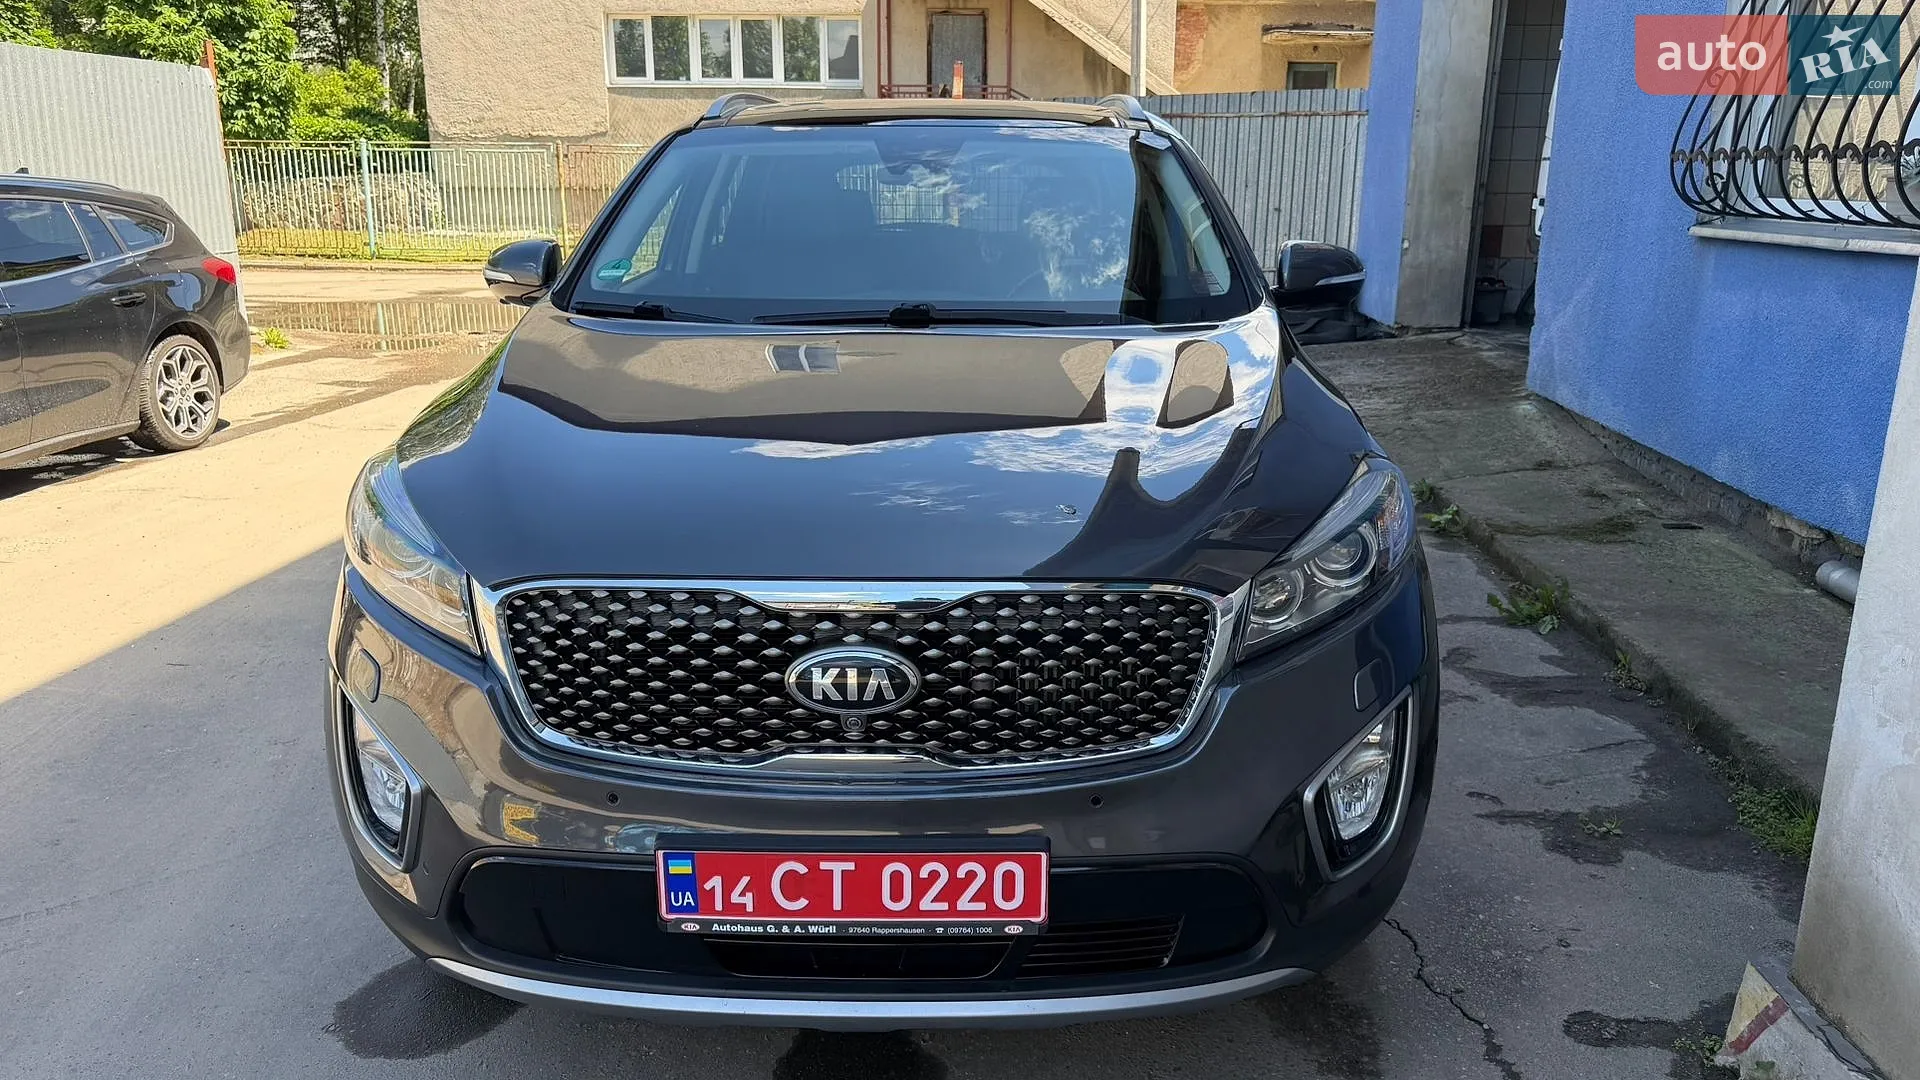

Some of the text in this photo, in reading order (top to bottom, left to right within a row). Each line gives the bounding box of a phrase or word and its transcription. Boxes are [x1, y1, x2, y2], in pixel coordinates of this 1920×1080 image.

[810, 667, 896, 701] KIA
[703, 860, 1025, 912] 14 CT 0220
[670, 891, 695, 907] UA
[711, 923, 764, 932] Autohaus
[766, 924, 779, 933] G.
[781, 925, 790, 933] &
[794, 925, 805, 933] A.
[871, 927, 925, 935] Rappershausen
